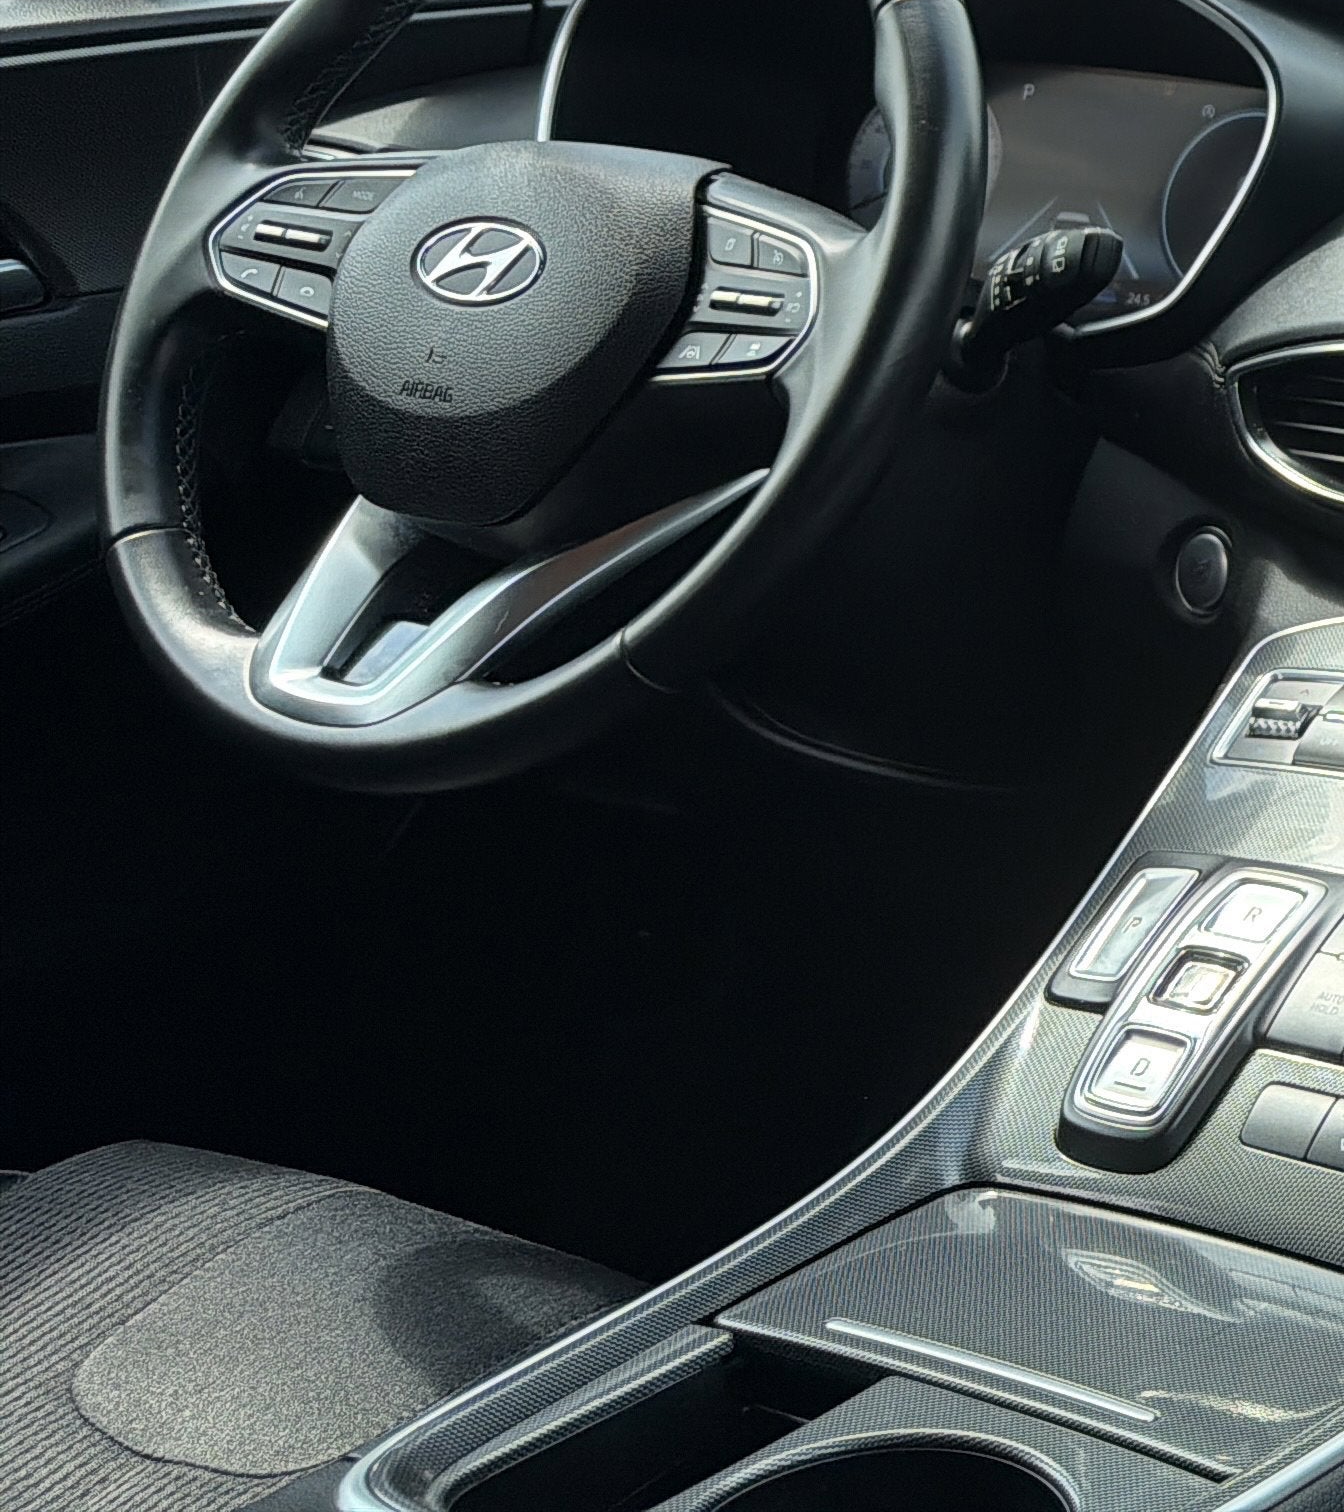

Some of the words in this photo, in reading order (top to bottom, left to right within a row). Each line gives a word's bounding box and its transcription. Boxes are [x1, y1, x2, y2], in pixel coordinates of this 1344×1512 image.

[399, 379, 454, 403] AIRBAG
[1242, 905, 1263, 923] R
[1122, 916, 1143, 934] P
[1129, 1056, 1151, 1078] D
